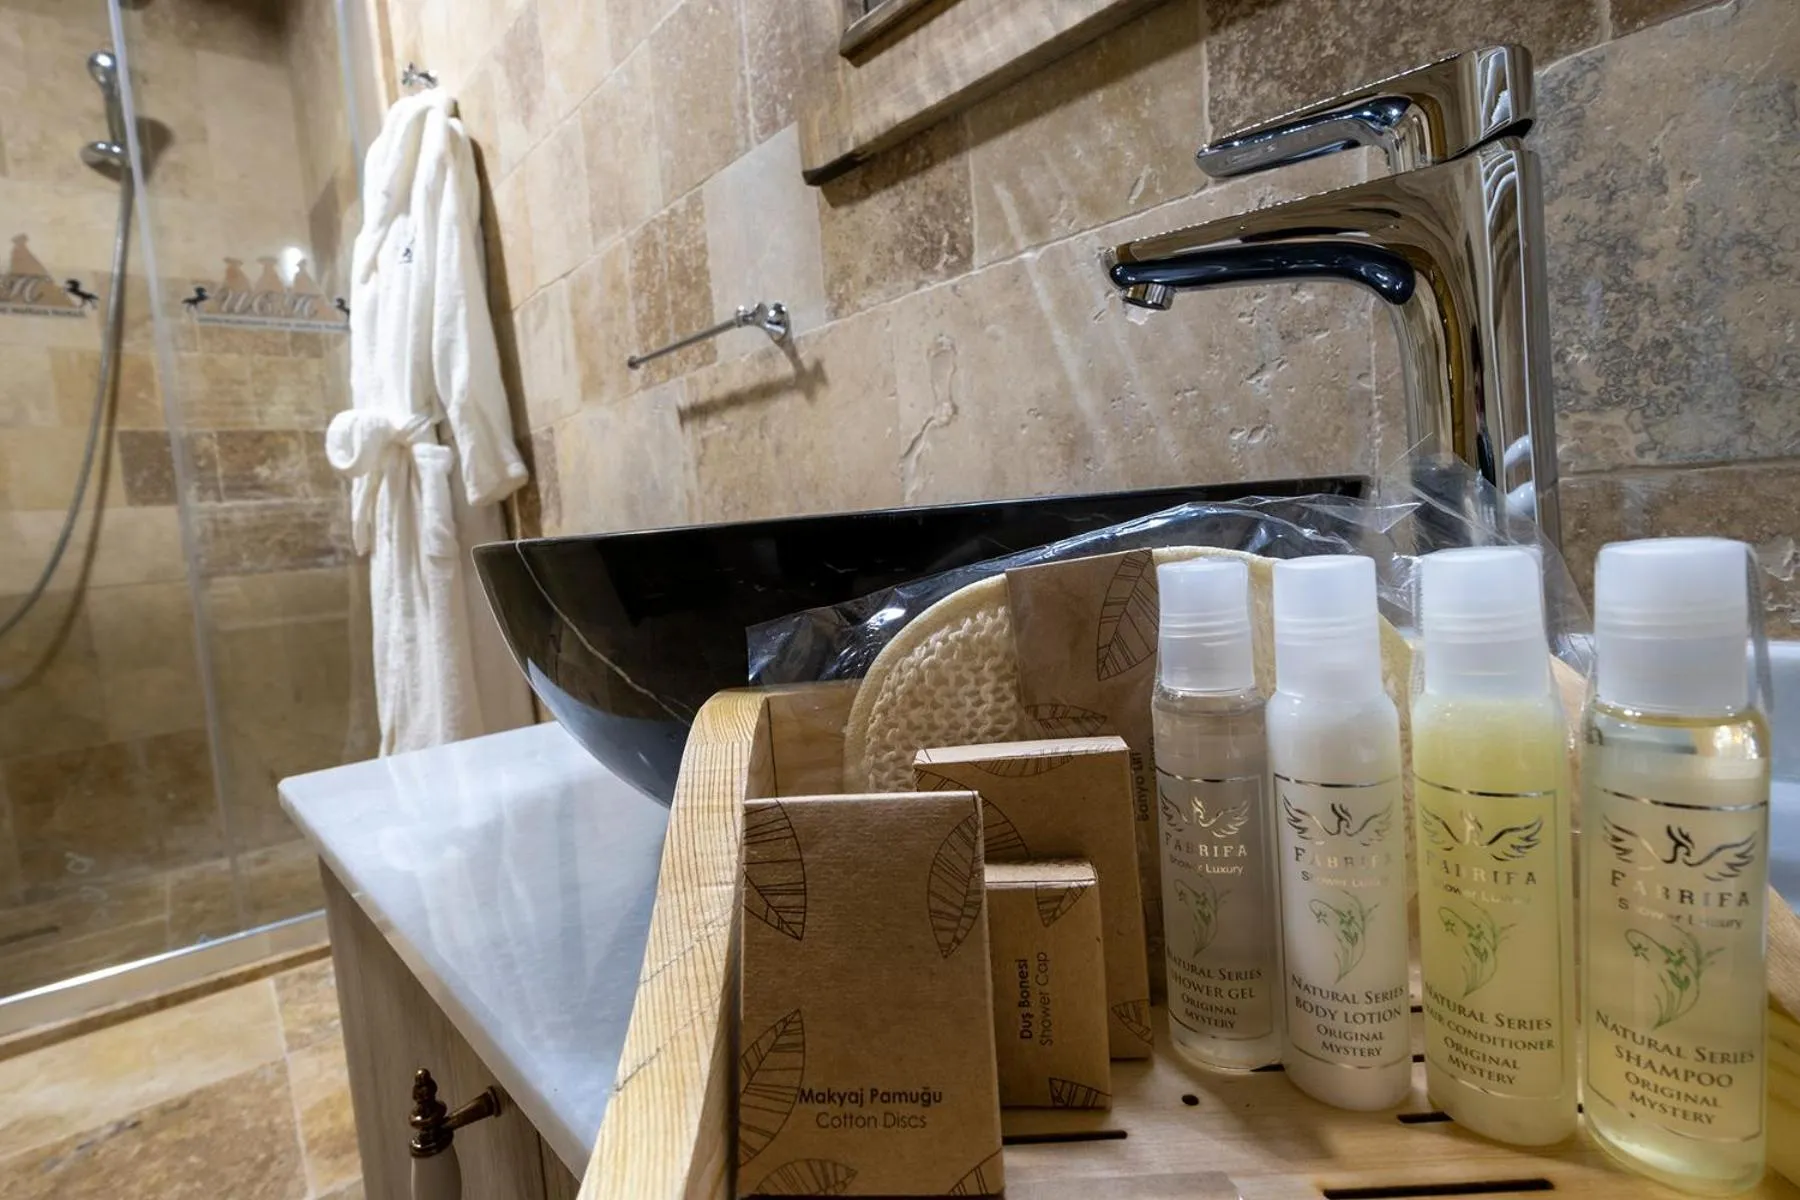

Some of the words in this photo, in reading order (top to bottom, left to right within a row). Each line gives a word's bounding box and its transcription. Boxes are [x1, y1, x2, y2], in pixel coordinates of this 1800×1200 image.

[1205, 863, 1245, 877] Luxury
[1015, 958, 1031, 1008] Bonesi
[1035, 951, 1050, 986] Cap
[1181, 992, 1239, 1016] ORIGINAL
[1228, 986, 1256, 1001] GEL
[1291, 973, 1359, 1005] NATURAL
[1038, 991, 1054, 1047] Shower
[1184, 1011, 1236, 1030] MYSTERY
[1295, 995, 1338, 1021] BODY
[1344, 1005, 1401, 1025] LOTION
[1424, 981, 1488, 1024] NATURAL
[1495, 1011, 1553, 1031] SERIES
[1020, 1012, 1035, 1040] Duş
[1316, 1023, 1384, 1042] ORIGINAL
[1446, 1019, 1556, 1051] CONDITIONER
[1595, 1009, 1688, 1060] NATURAL
[1321, 1040, 1382, 1057] MYSTERY
[1443, 1036, 1520, 1070] ORIGINAL
[1447, 1054, 1517, 1085] MYSTERY
[1614, 1044, 1733, 1088] SHAMPOO
[799, 1088, 864, 1108] Makyaj
[870, 1085, 943, 1108] Pamuğu
[1624, 1071, 1722, 1109] ORIGINAL
[815, 1111, 878, 1129] Cotton
[883, 1111, 928, 1129] Discs
[1629, 1090, 1717, 1125] MYSTERY
